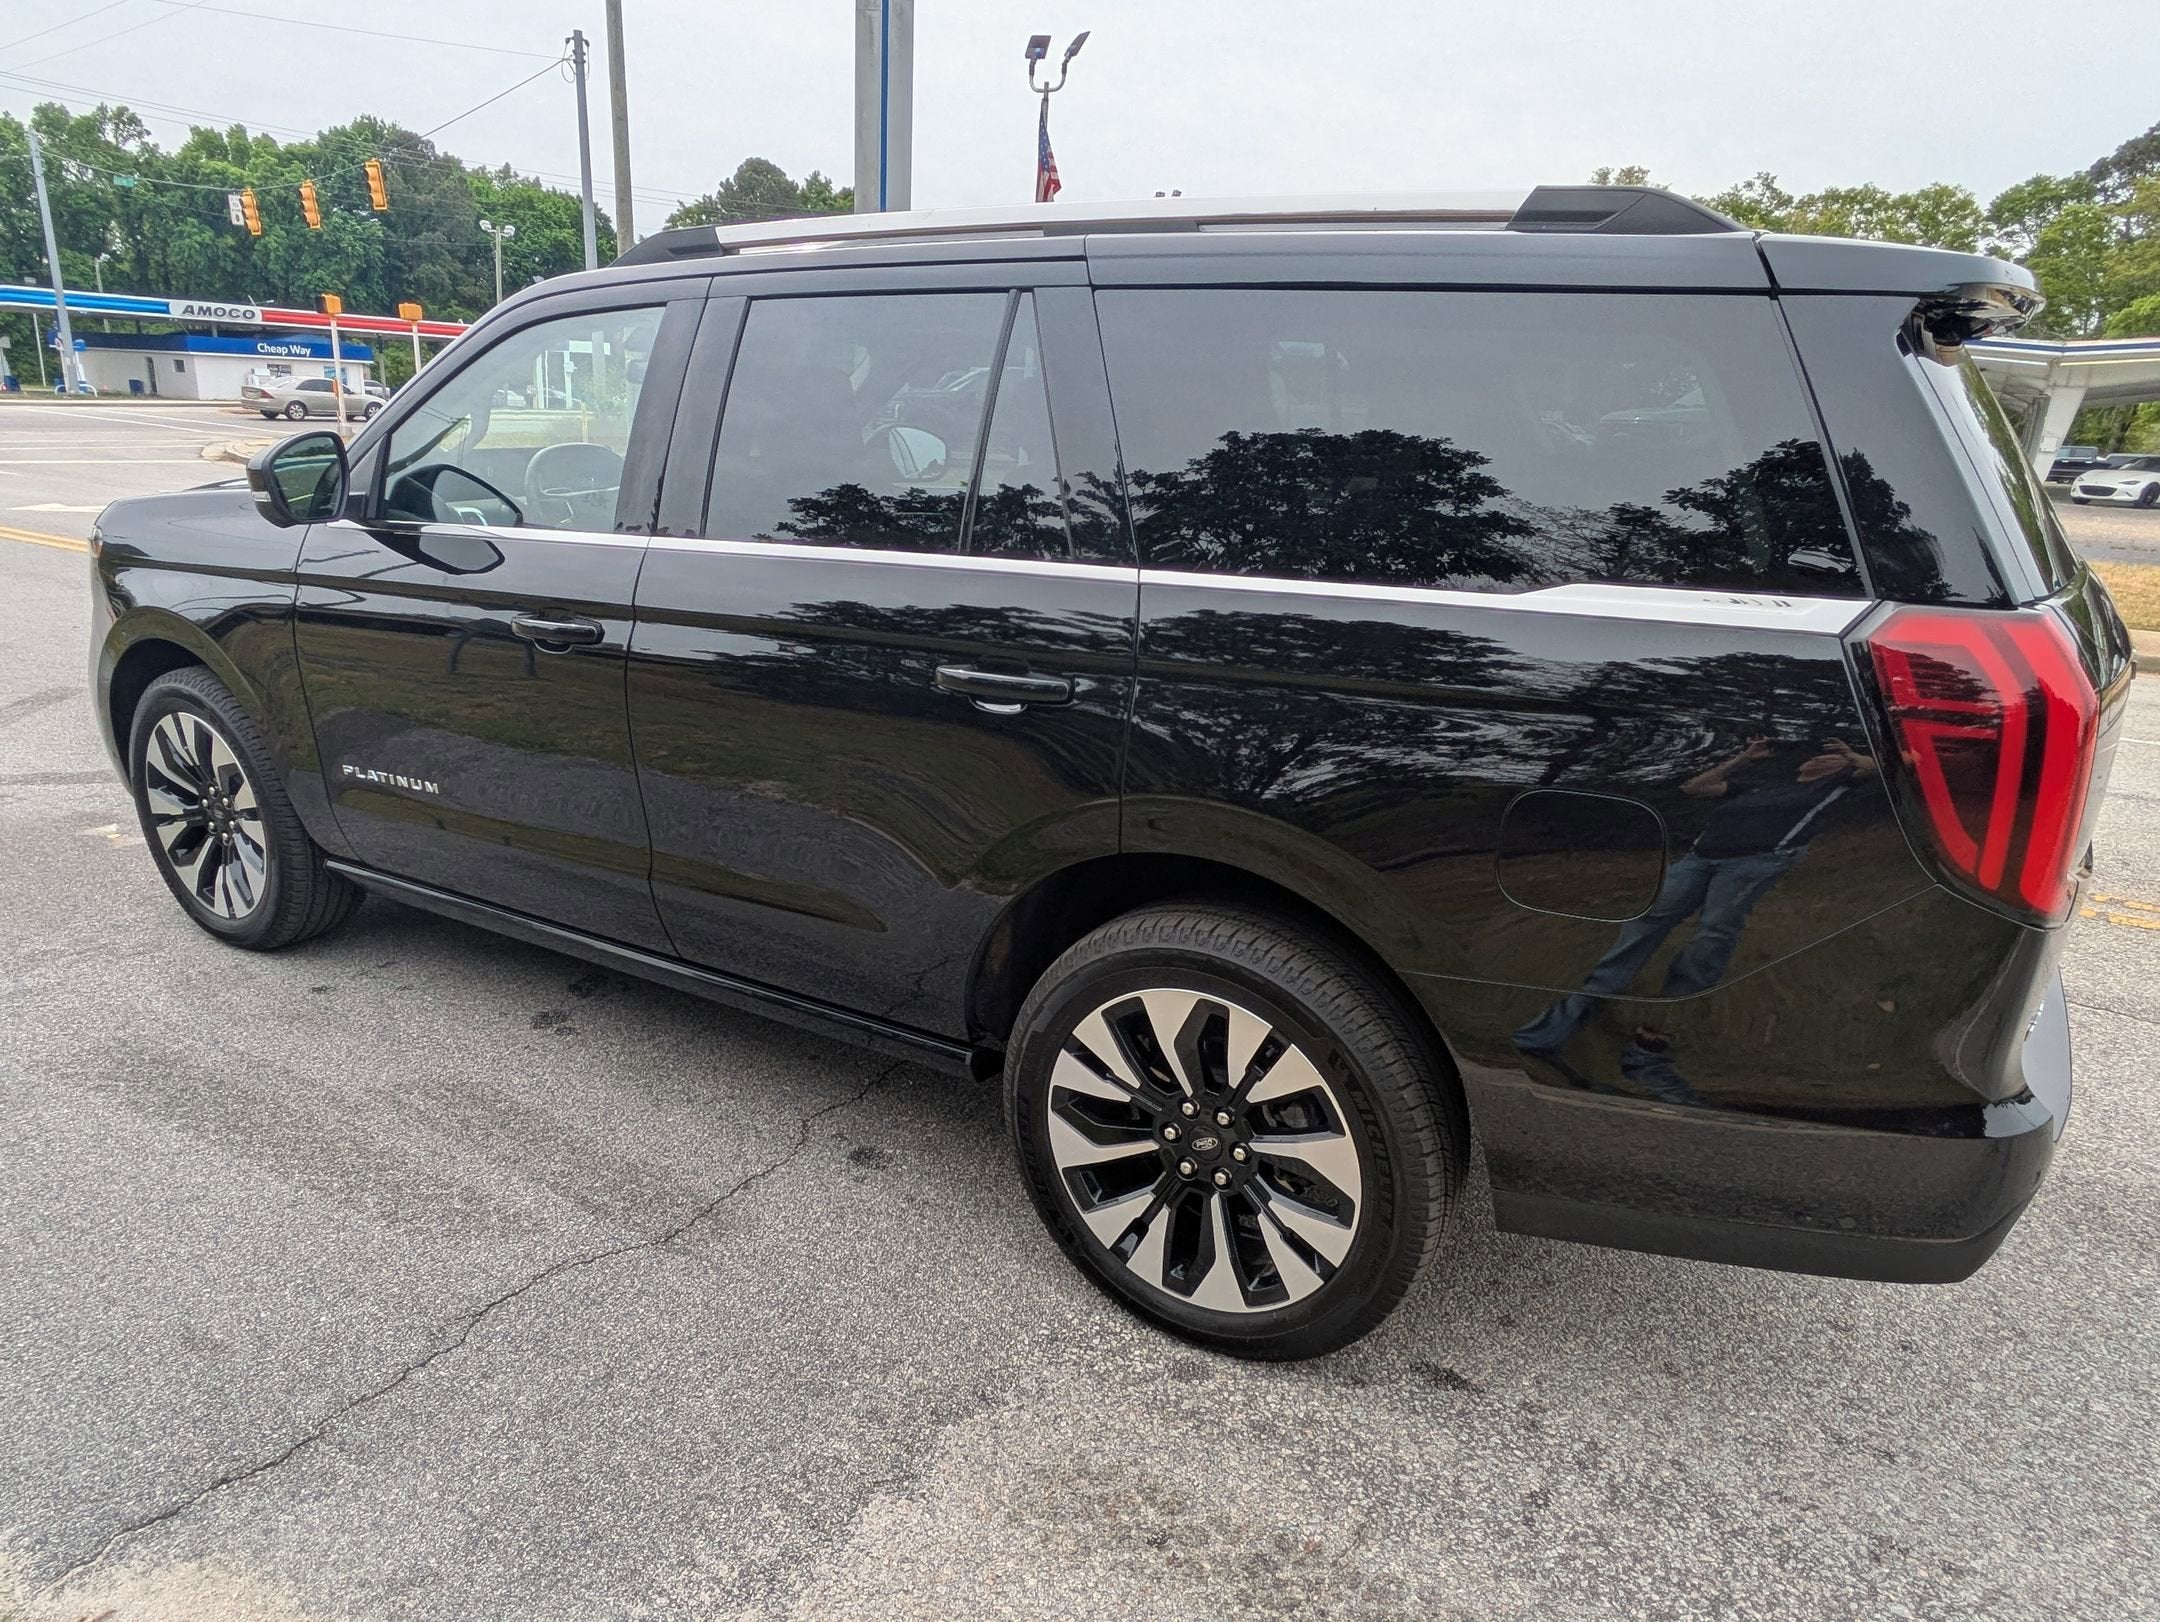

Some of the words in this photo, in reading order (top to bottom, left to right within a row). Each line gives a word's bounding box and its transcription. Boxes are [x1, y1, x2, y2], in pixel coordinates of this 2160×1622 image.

[182, 304, 256, 320] AMOCO
[257, 342, 288, 355] Cheap
[289, 344, 311, 357] Way
[342, 764, 439, 794] PLATINUM
